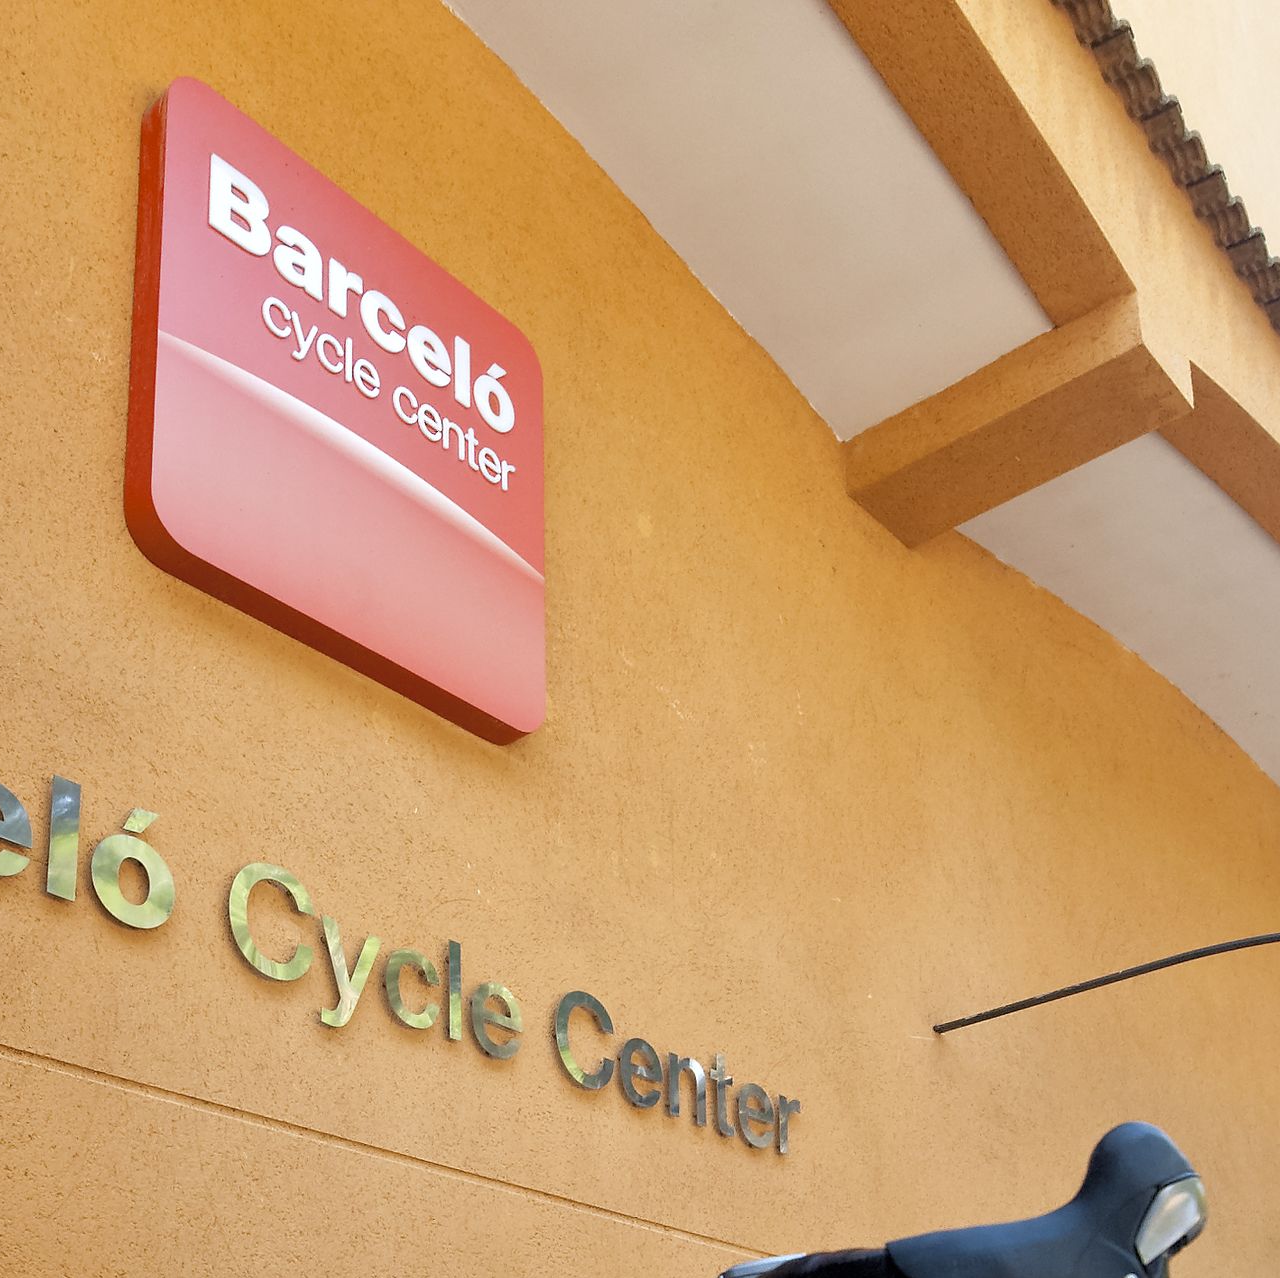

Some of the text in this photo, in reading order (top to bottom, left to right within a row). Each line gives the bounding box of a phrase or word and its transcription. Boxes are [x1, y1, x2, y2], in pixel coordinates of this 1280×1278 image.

[209, 152, 515, 433] Barceló
[261, 296, 516, 491] cycle center
[228, 861, 522, 1060] Cycle
[553, 989, 801, 1155] Center
